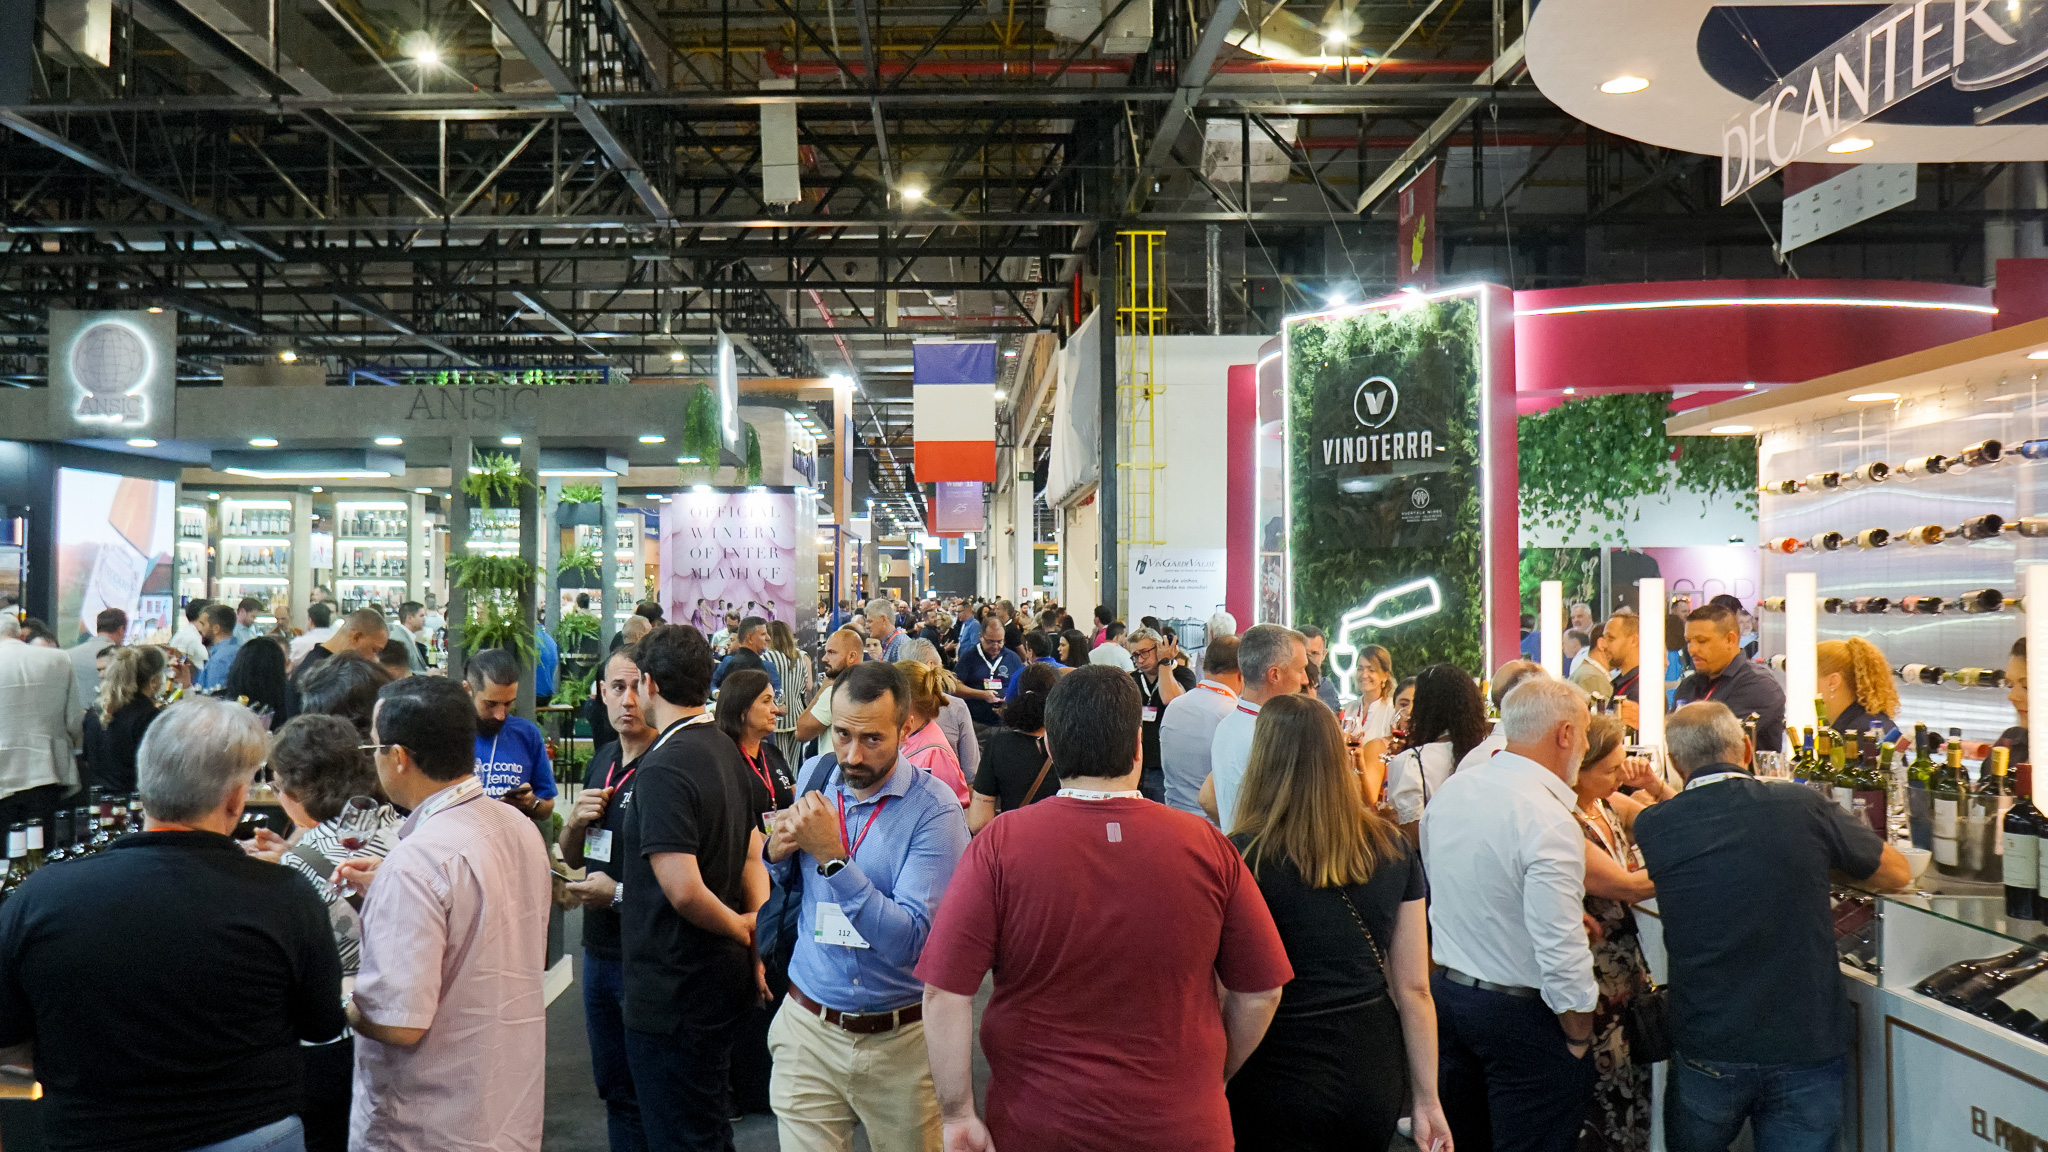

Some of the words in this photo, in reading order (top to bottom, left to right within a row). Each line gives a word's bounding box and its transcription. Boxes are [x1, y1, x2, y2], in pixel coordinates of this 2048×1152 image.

[1722, 0, 2016, 206] DECANTER
[79, 397, 141, 415] ANSIC
[405, 387, 540, 420] ANSIC
[1322, 430, 1432, 465] VINOTERRA
[690, 506, 780, 518] OFFICIAL
[691, 527, 779, 539] WINERY
[690, 547, 714, 559] OF
[723, 547, 779, 559] INTER
[691, 567, 749, 580] MIAMI
[757, 567, 781, 580] CF
[493, 762, 522, 773] conta
[838, 929, 851, 937] 112
